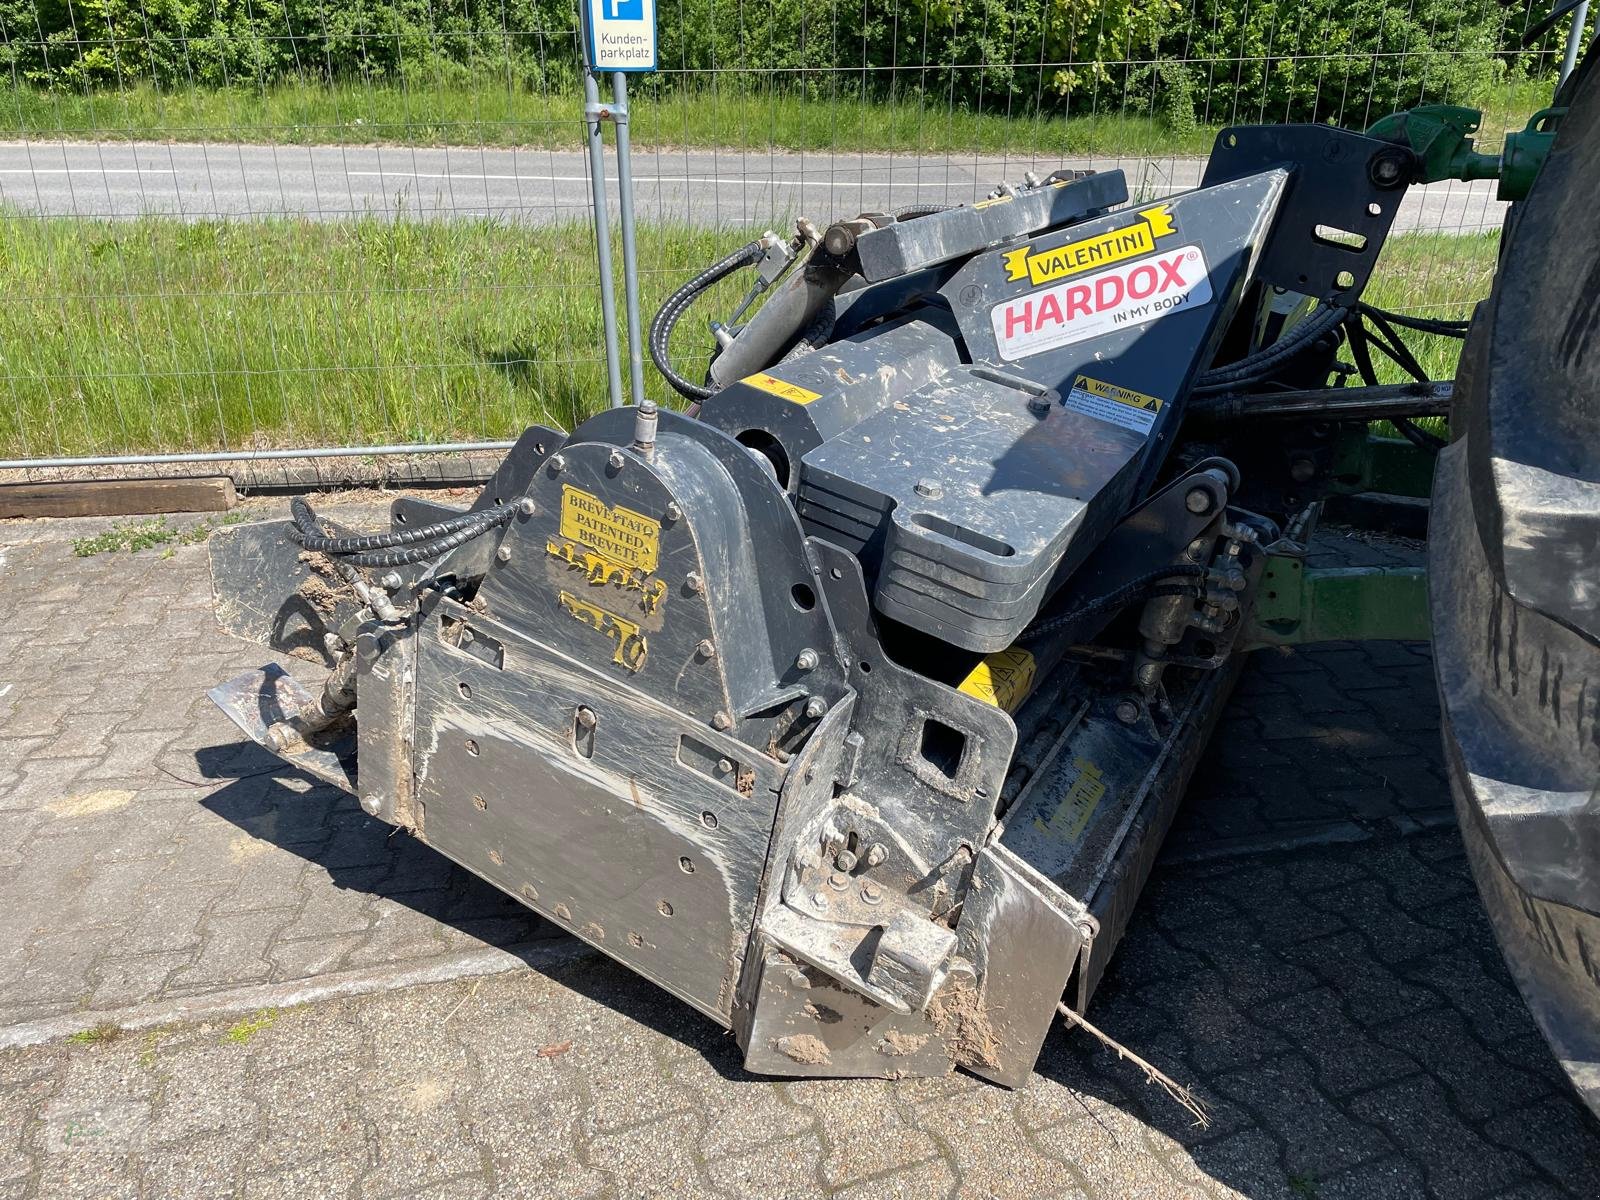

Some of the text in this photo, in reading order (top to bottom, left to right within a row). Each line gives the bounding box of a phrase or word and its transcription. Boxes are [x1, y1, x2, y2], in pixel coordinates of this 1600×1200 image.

[601, 32, 648, 45] Kunden-
[600, 47, 650, 61] parkplatz
[1037, 231, 1144, 276] VALENTINI
[1113, 291, 1191, 324] IN MY BODY
[1094, 382, 1142, 404] WARNING
[576, 513, 645, 549] PATENTED
